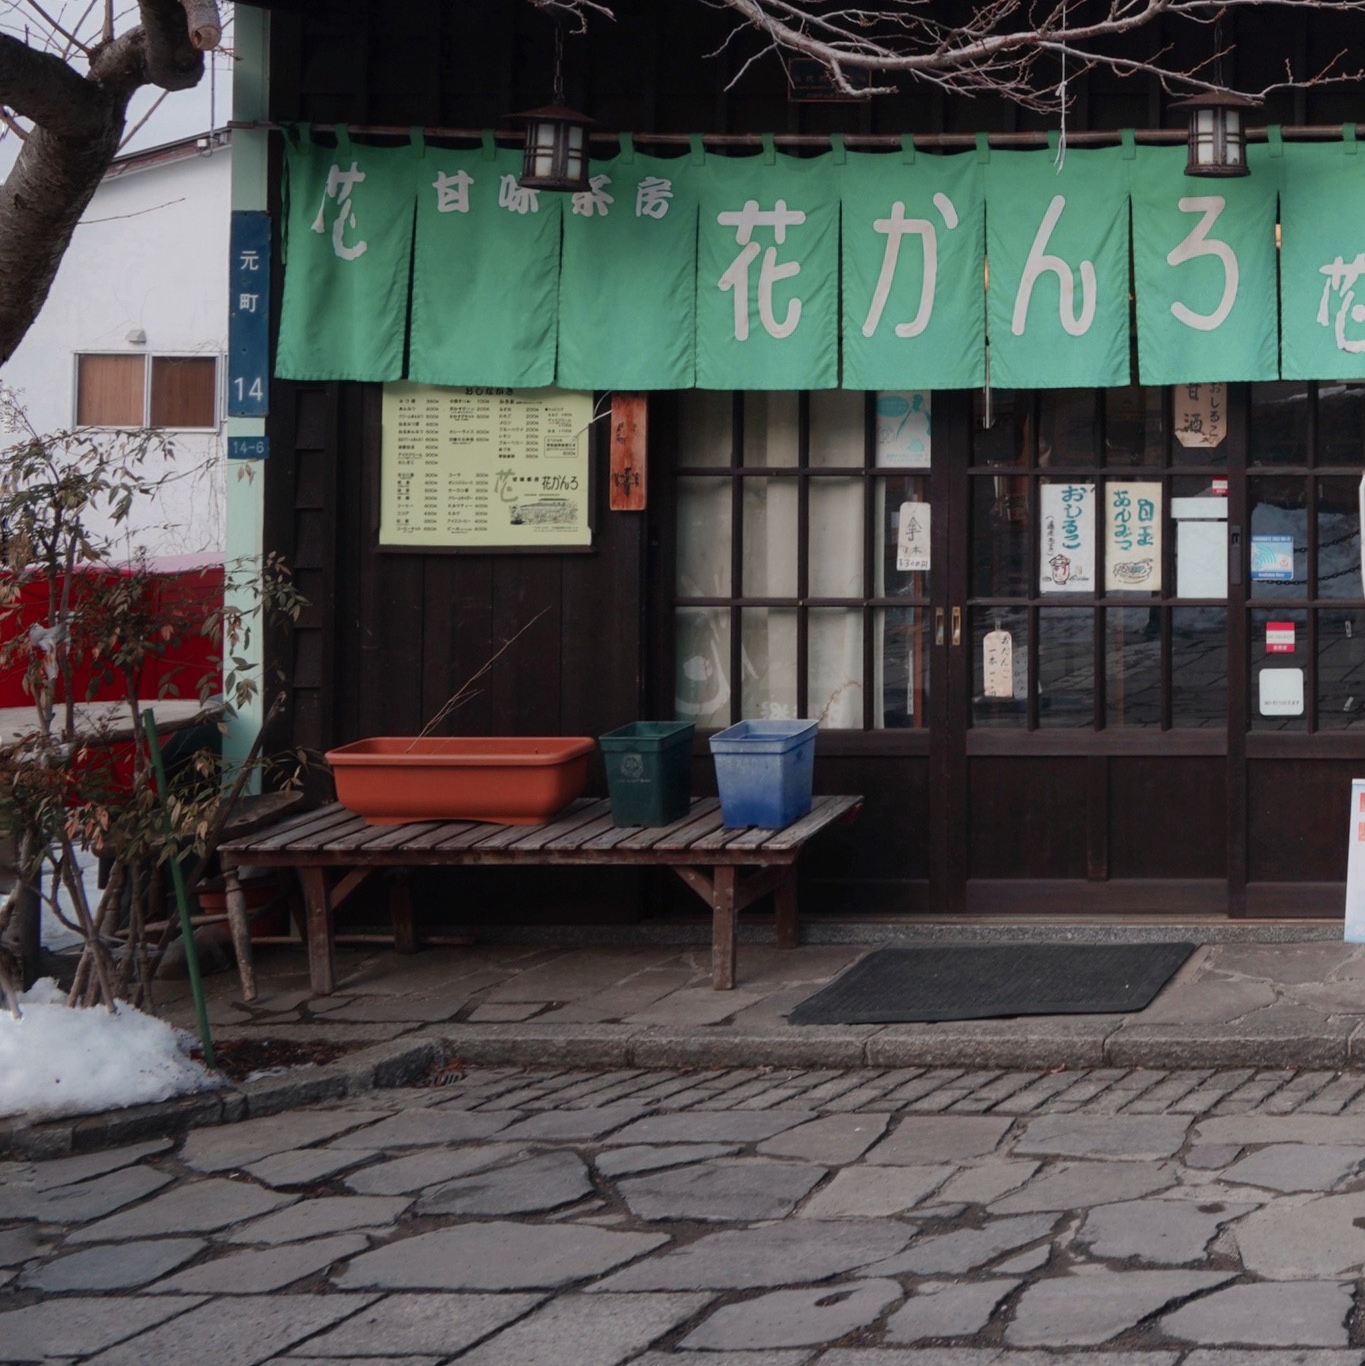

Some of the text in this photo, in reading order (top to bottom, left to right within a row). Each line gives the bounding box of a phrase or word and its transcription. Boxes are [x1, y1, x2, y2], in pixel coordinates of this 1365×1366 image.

[239, 250, 260, 313] 元町
[234, 376, 264, 403] 14
[232, 440, 265, 454] 14-6
[1061, 485, 1088, 550] おしるこ
[1113, 489, 1133, 552] あんみつ
